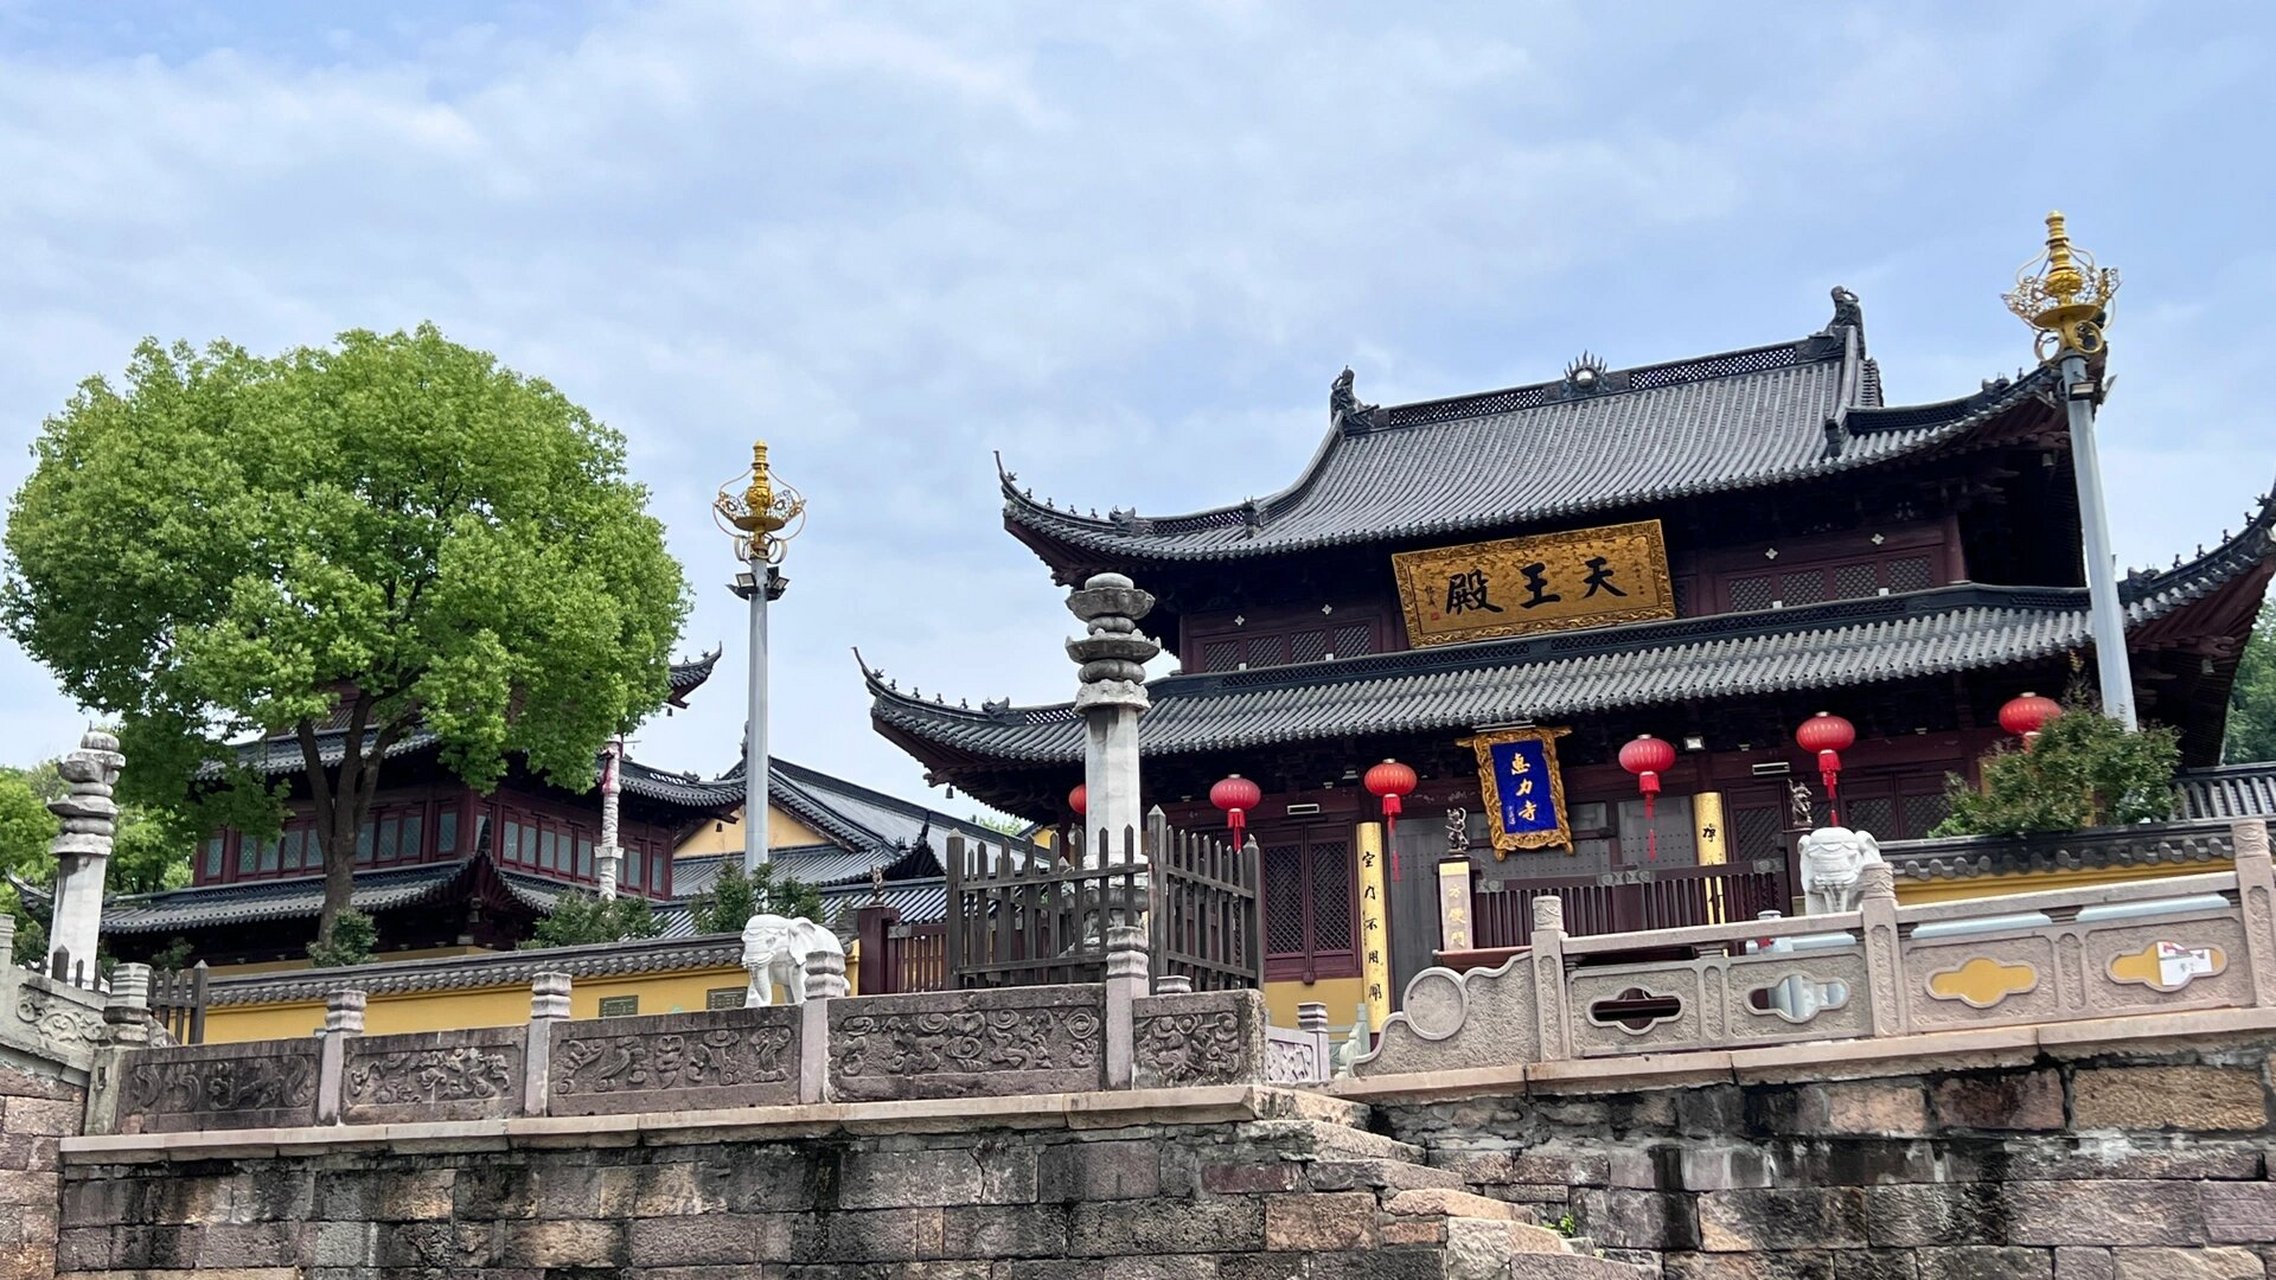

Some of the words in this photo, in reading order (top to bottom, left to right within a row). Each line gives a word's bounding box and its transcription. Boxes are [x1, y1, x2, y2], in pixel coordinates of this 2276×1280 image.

[1446, 556, 1628, 615] 天王殿
[1511, 752, 1538, 822] 惠力寺
